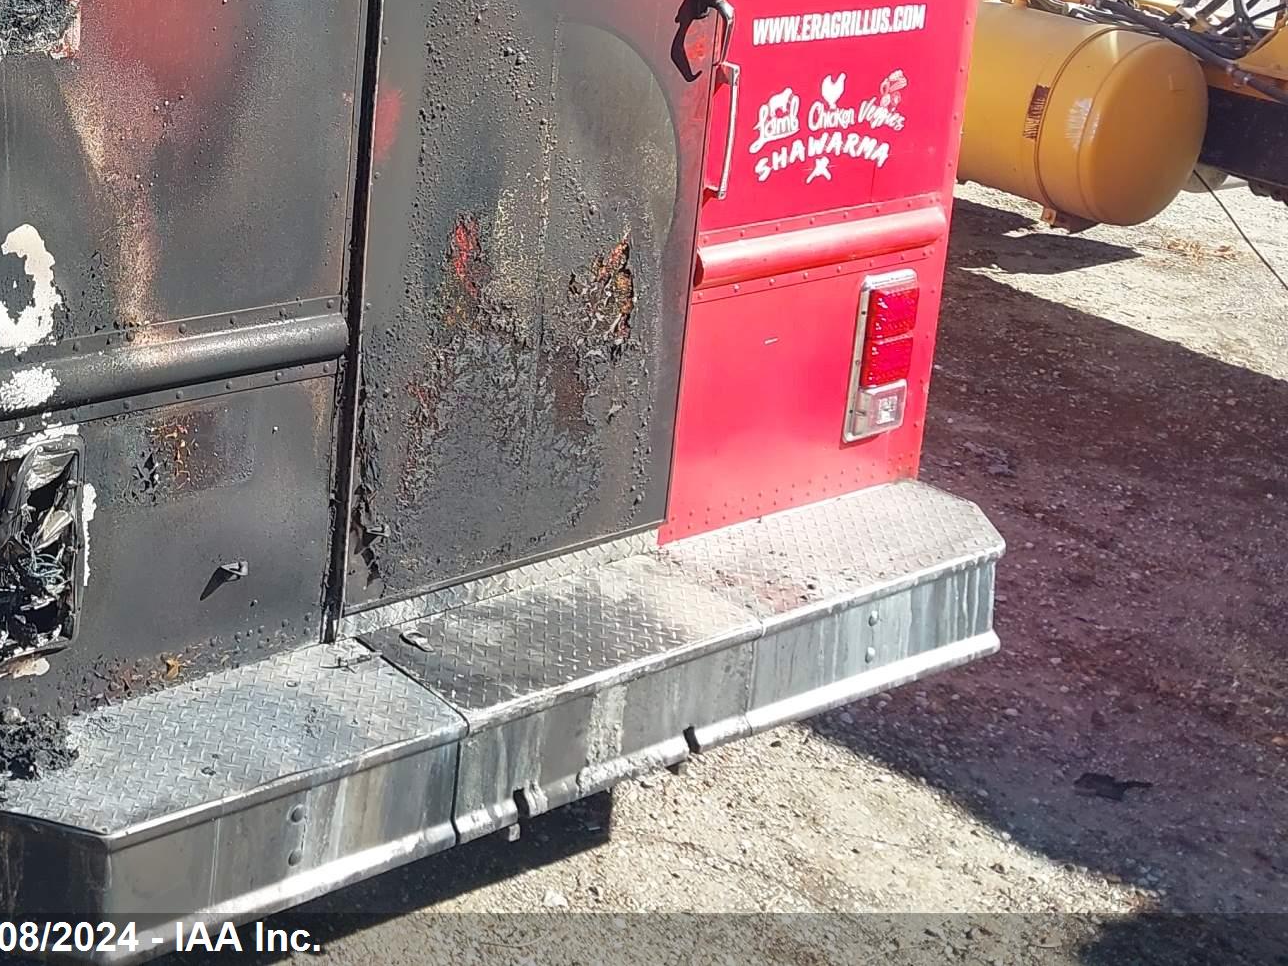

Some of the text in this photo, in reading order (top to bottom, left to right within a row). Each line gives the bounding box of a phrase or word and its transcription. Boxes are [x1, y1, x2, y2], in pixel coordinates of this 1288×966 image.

[752, 4, 927, 46] WWW.ERAGRILLUS.COM
[808, 101, 856, 132] Chicken
[754, 131, 890, 182] SHAWARMA
